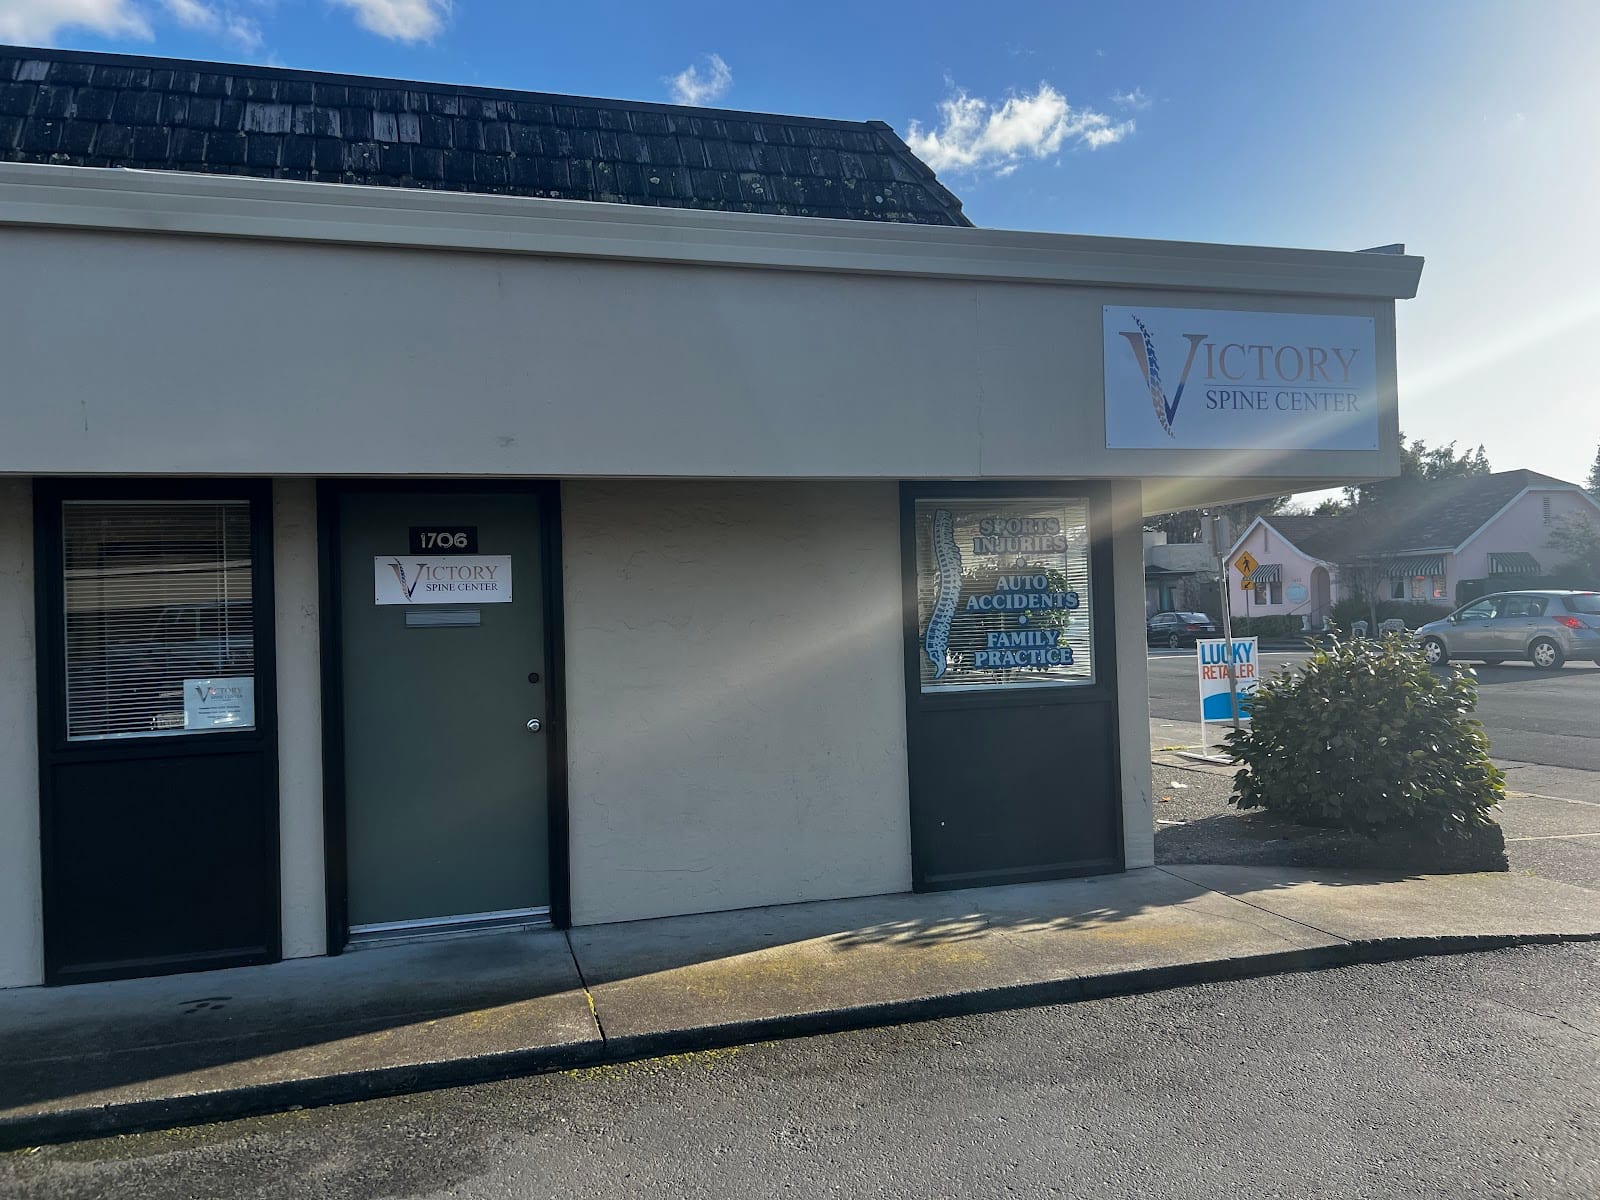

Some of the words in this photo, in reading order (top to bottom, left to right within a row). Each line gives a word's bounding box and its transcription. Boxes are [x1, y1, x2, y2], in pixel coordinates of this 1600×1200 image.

[1119, 331, 1360, 427] VICTORY
[1206, 390, 1269, 411] SPINE
[1275, 391, 1361, 412] CENTER
[980, 518, 1060, 536] SPORTS
[420, 532, 468, 549] 1706
[973, 536, 1068, 554] INJURIES
[387, 563, 500, 598] VICTORY
[426, 583, 455, 592] SPINE
[458, 582, 498, 592] CENTER
[995, 574, 1050, 593] AUTO
[966, 592, 1079, 612] ACCIDENTS
[987, 629, 1060, 648] FAMILY
[974, 648, 1073, 668] PRACTICE
[1201, 642, 1253, 664] LUCKY
[1202, 664, 1254, 680] RETALER
[195, 686, 242, 703] VTORY
